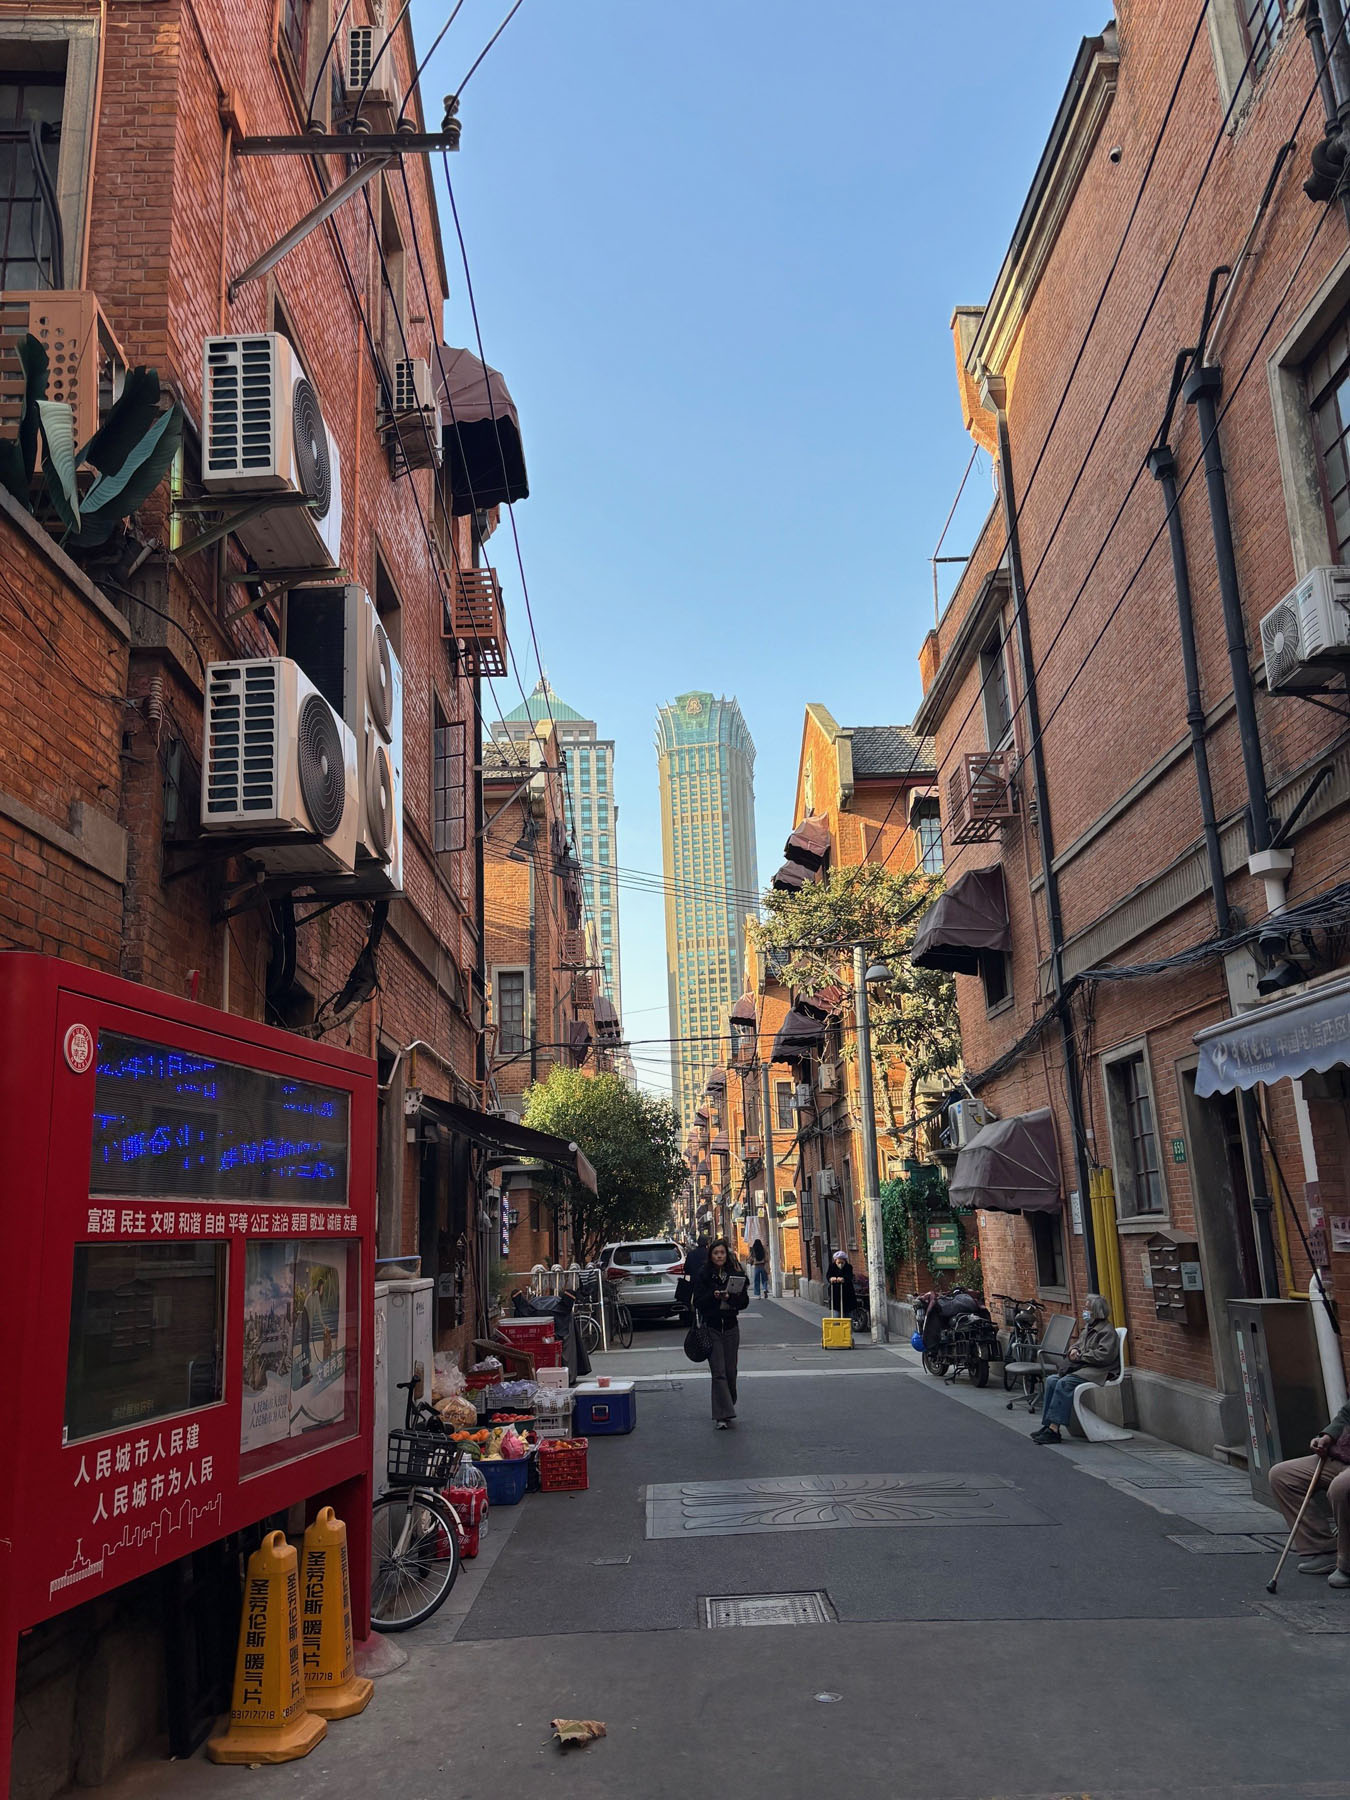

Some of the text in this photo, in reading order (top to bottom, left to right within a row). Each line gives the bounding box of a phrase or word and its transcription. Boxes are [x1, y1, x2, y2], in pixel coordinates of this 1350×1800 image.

[1277, 1013, 1350, 1056] 中国电信西区
[87, 1208, 357, 1234] 富强 民主 文明 和谐 自由 平等 公正 法治 爱国 敬业 诚信 友善
[74, 1423, 200, 1487] 人民城市人民建
[92, 1456, 213, 1525] 人民城市为人民
[243, 1579, 270, 1705] 圣劳伦斯 暖气片
[302, 1551, 326, 1667] 圣劳伦斯 暖气片
